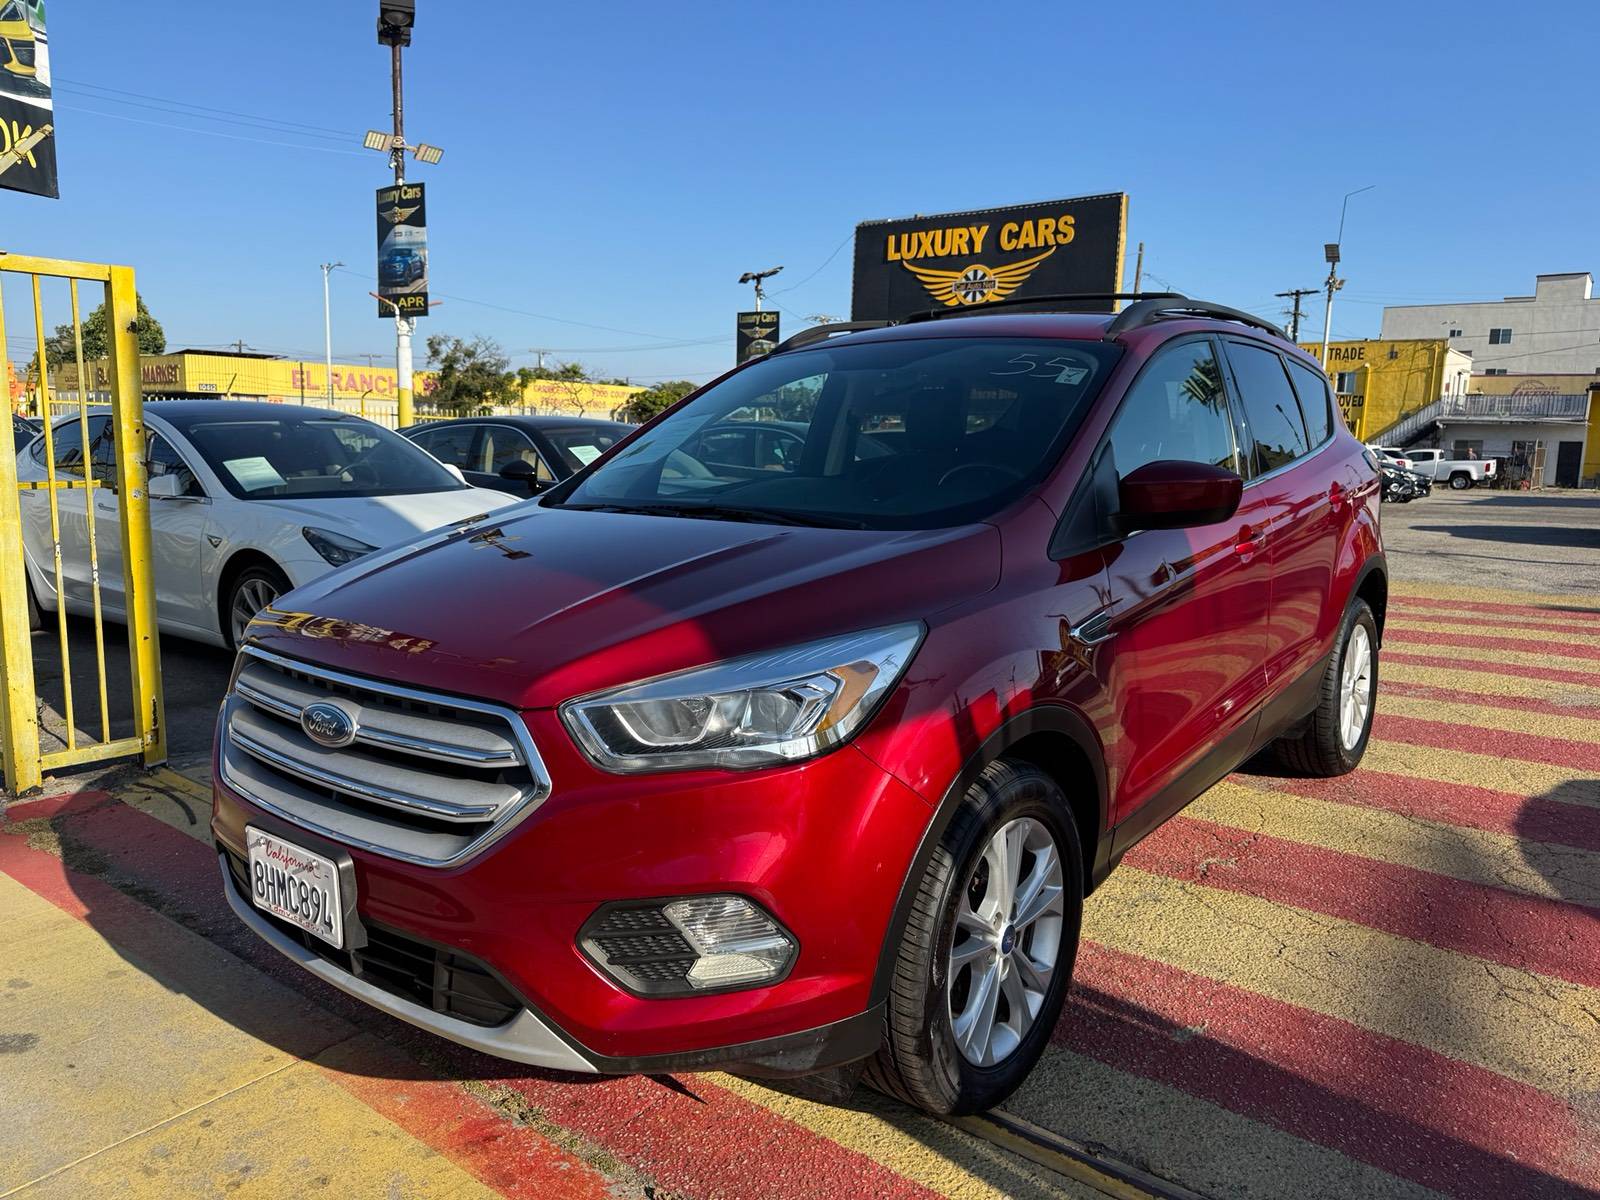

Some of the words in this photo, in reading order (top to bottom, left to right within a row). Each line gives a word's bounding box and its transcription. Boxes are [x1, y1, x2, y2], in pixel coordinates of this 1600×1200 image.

[401, 186, 421, 200] Cars
[887, 224, 990, 261] LUXURY
[1000, 215, 1076, 251] CARS
[398, 296, 425, 308] APR
[1329, 347, 1365, 360] TRADE
[142, 364, 181, 384] MARKET
[292, 369, 320, 391] EL
[309, 711, 337, 735] Ford
[266, 839, 321, 879] California
[255, 861, 333, 934] 8HMC894
